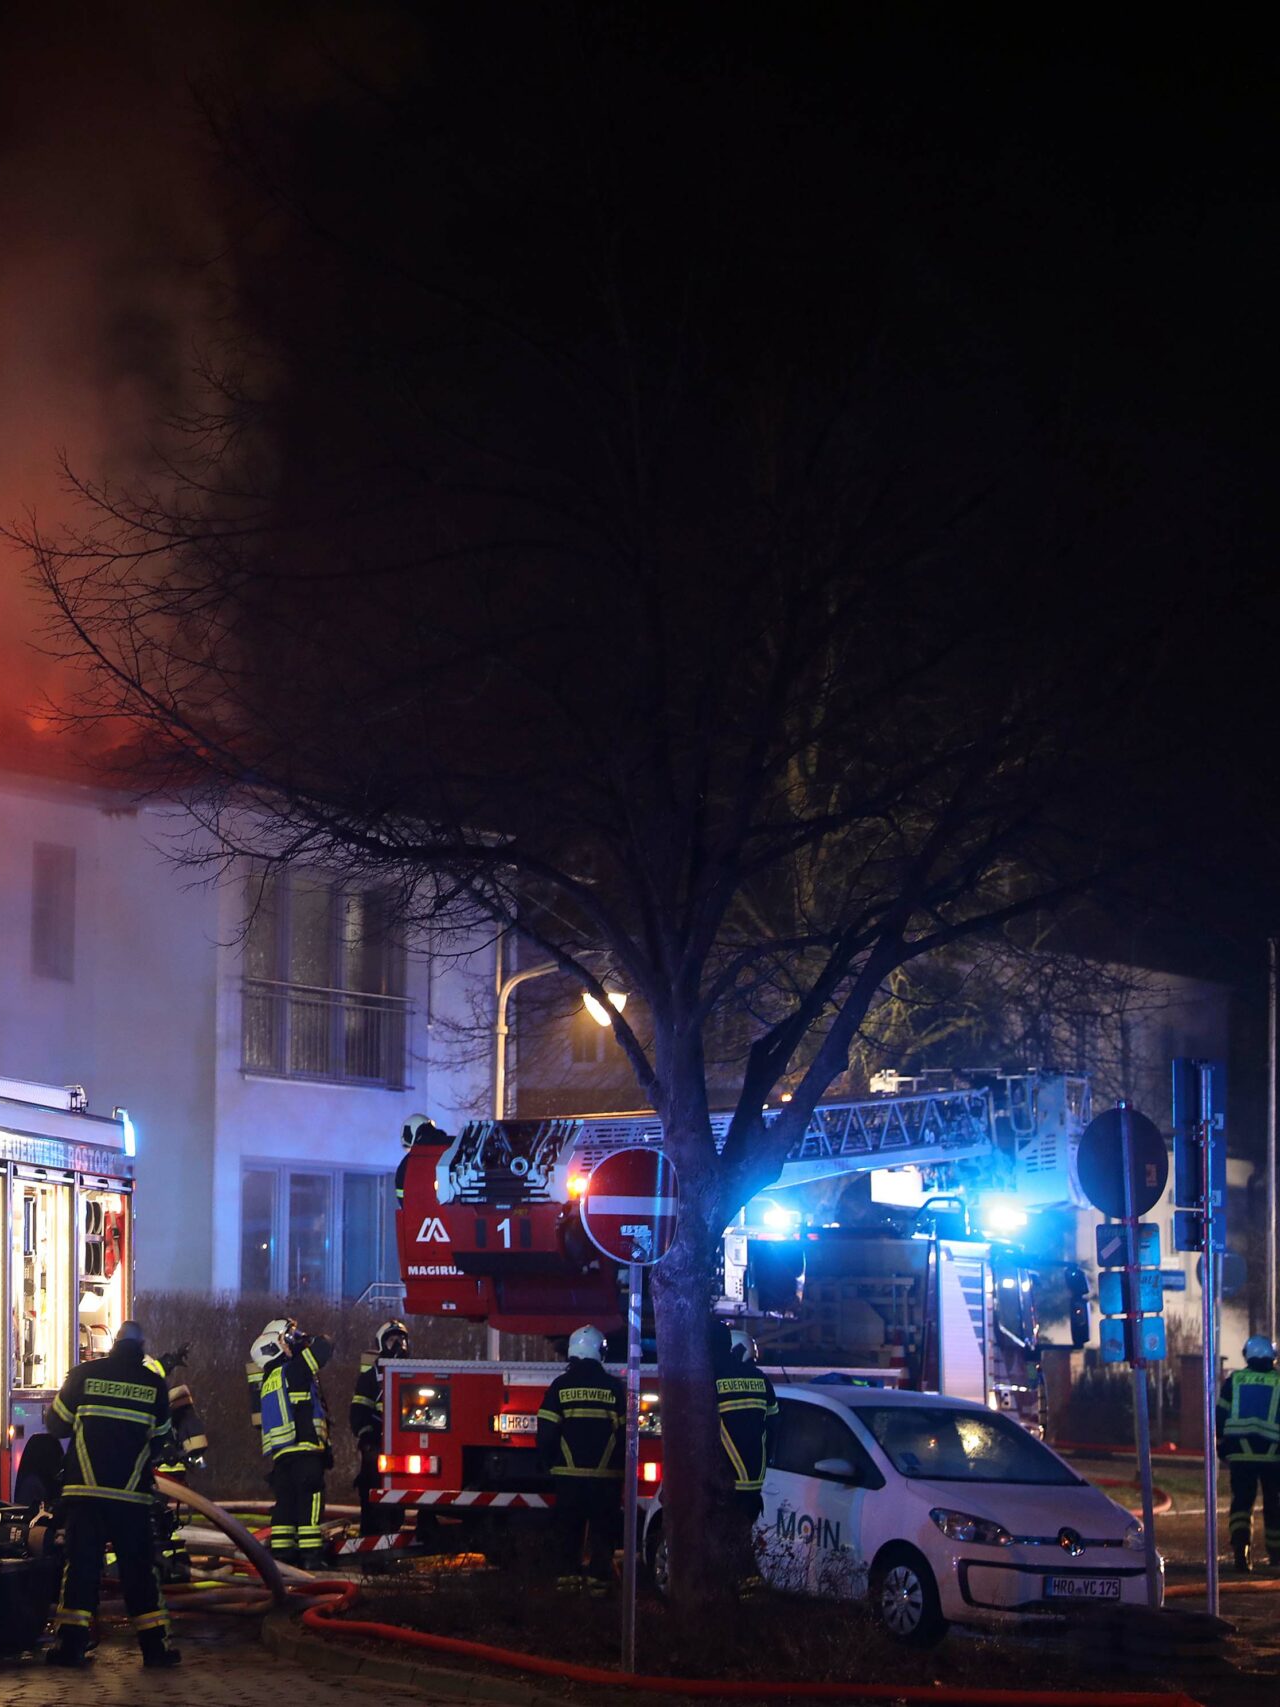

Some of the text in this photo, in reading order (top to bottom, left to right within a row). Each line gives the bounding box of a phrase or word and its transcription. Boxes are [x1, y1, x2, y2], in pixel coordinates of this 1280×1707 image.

[68, 1144, 116, 1177] ROSTOCK
[497, 1218, 511, 1249] 1
[87, 1380, 154, 1401] FEUERWEHR
[717, 1380, 765, 1391] FEUERWEHR
[508, 1416, 530, 1429] HRO
[1053, 1580, 1074, 1594] HRO
[1099, 1581, 1119, 1596] 175
